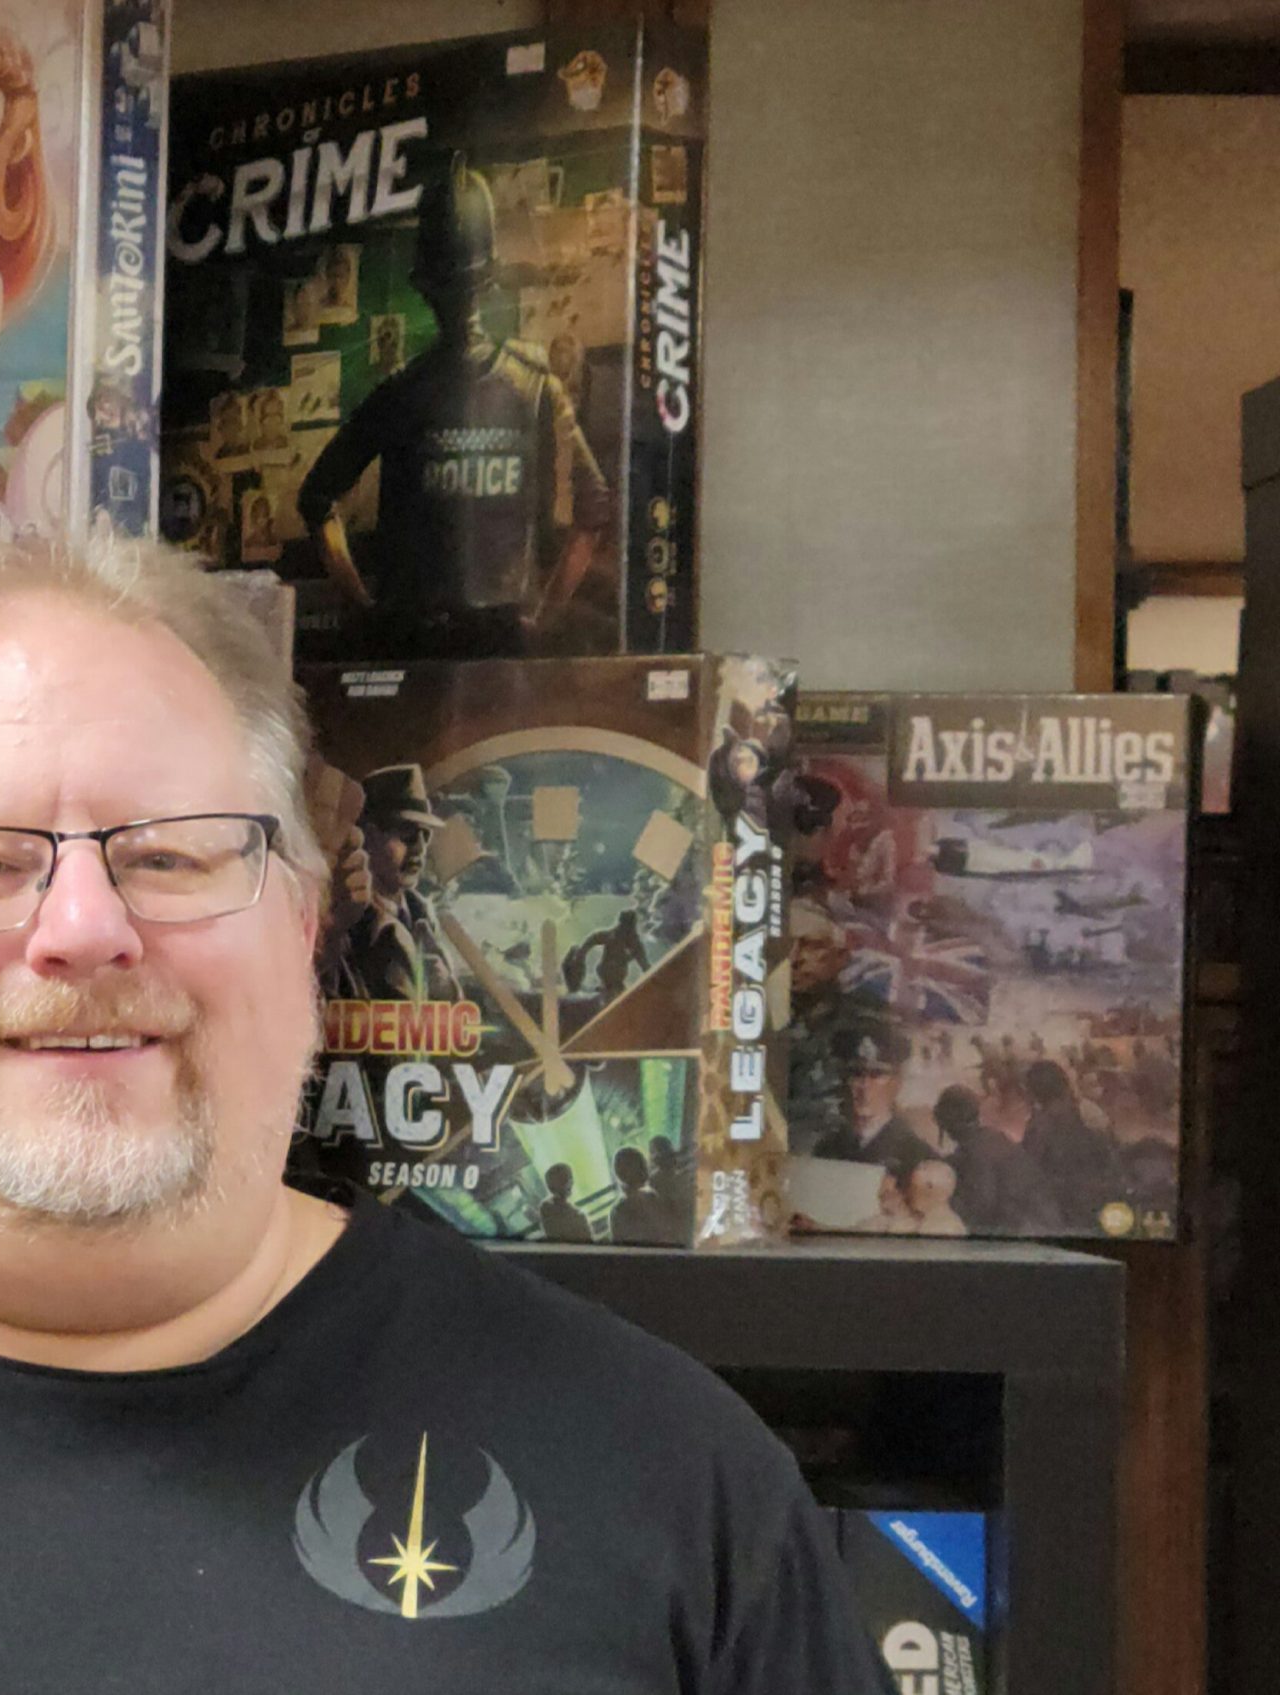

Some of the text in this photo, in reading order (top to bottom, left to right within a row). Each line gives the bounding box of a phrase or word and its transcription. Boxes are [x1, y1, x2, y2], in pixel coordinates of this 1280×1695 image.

[209, 72, 422, 150] CHRONICLES
[166, 117, 428, 265] CRIME
[655, 219, 691, 433] CRIME
[903, 715, 1017, 782] Axis
[1032, 716, 1175, 783] Allies
[709, 841, 733, 1031] PANDEMIC
[729, 814, 768, 1141] LEGACY
[368, 1161, 461, 1188] SEASON
